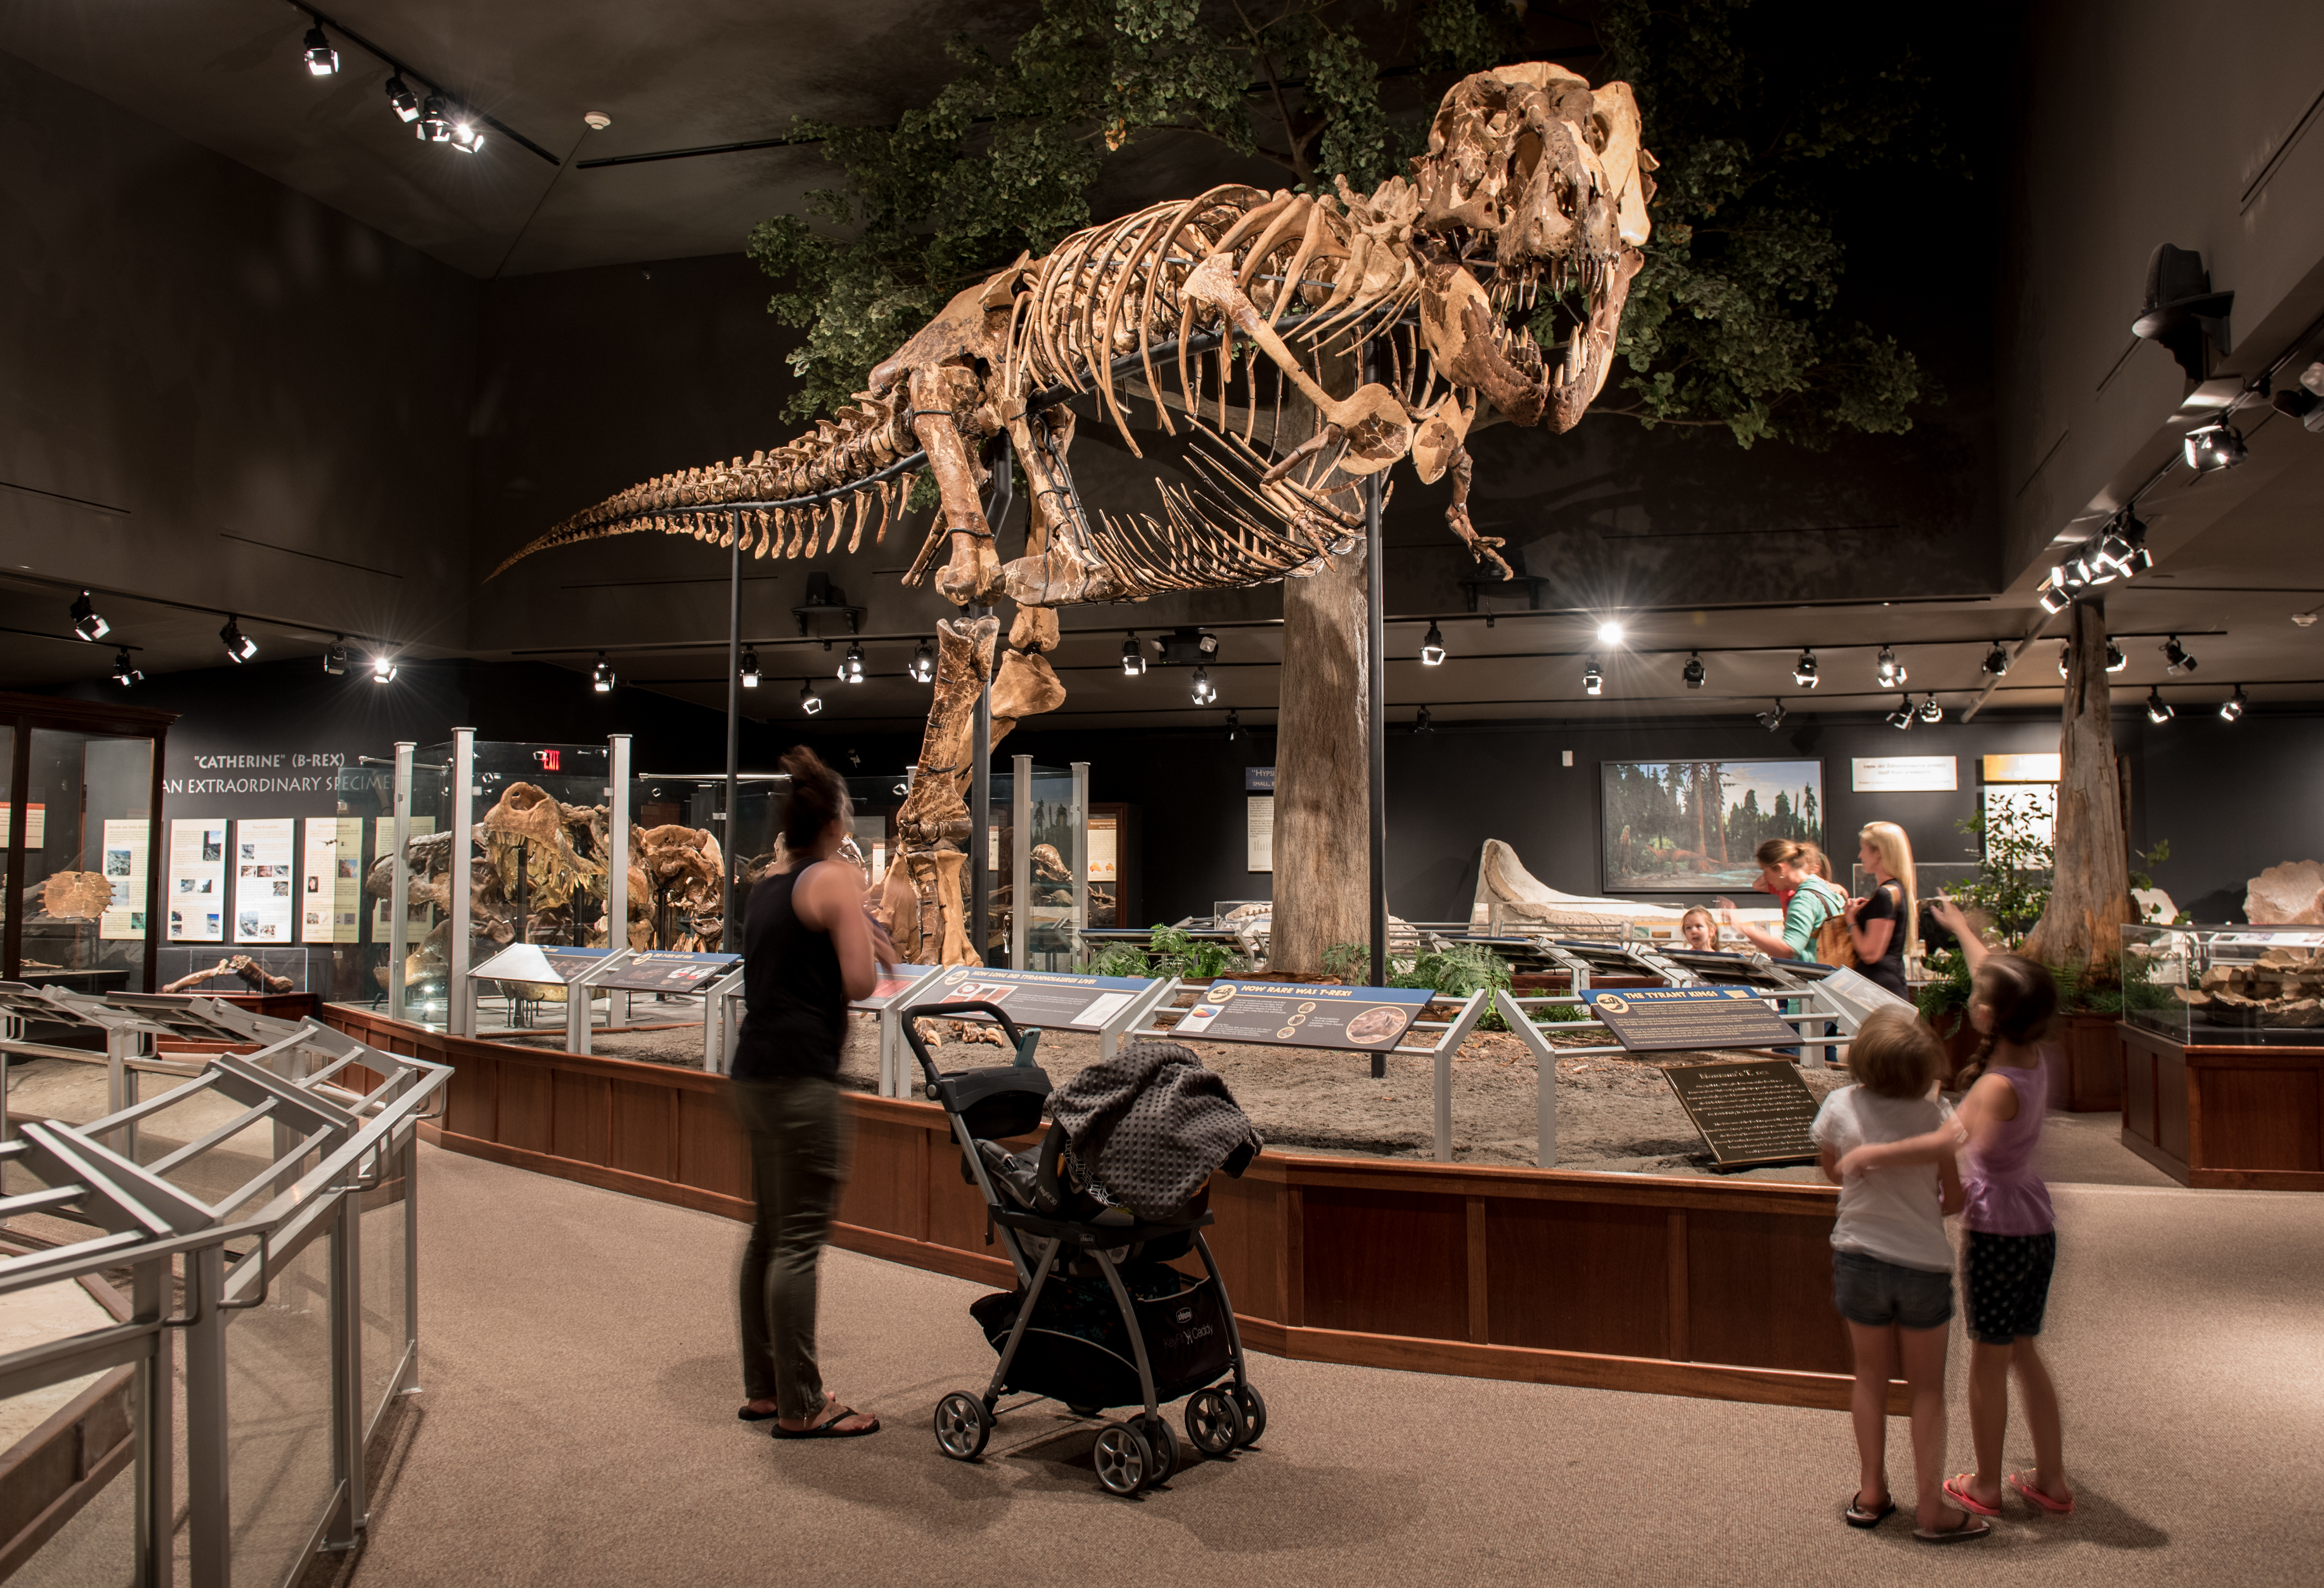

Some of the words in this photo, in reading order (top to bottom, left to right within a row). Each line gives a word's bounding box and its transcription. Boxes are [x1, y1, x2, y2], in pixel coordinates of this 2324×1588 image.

[194, 754, 285, 768] "CATHERINE"
[292, 752, 345, 768] (B-REX)
[544, 749, 560, 770] EXIT
[163, 779, 183, 793] AN
[188, 777, 322, 793] EXTRAORDINARY
[1020, 974, 1079, 983] TYRANNOSAURUS
[1177, 1310, 1191, 1321] chicco
[1163, 1333, 1185, 1349] KeyFit
[1192, 1323, 1213, 1339] Caddy
